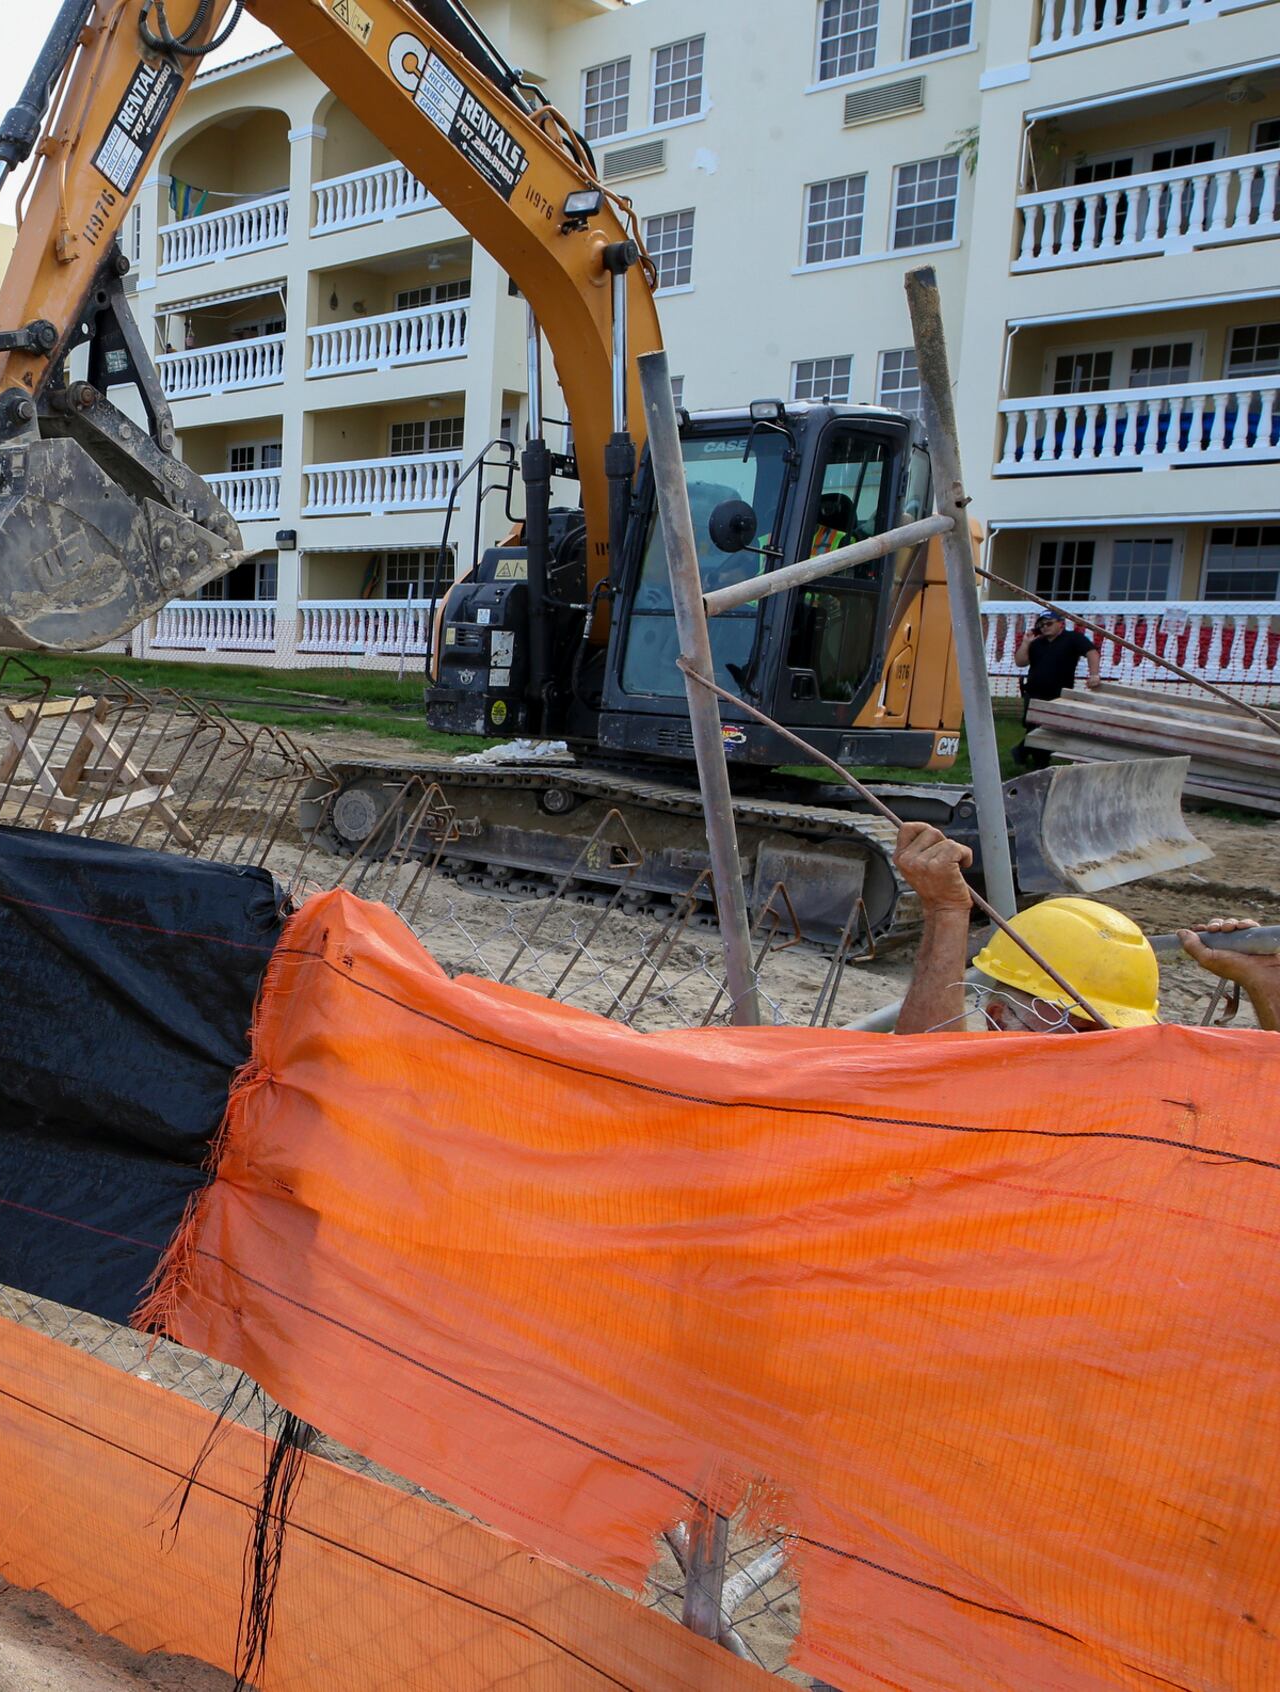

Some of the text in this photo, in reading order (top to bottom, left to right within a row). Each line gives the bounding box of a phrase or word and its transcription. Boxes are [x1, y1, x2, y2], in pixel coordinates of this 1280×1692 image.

[427, 71, 446, 94] RICO
[432, 60, 461, 93] PUERTO
[118, 64, 158, 131] RENTAL
[419, 97, 446, 125] GROUP
[423, 83, 444, 107] WIRE
[460, 93, 522, 170] RENTALS
[82, 189, 116, 246] 11976
[525, 184, 554, 220] 11976
[703, 440, 748, 453] CASE
